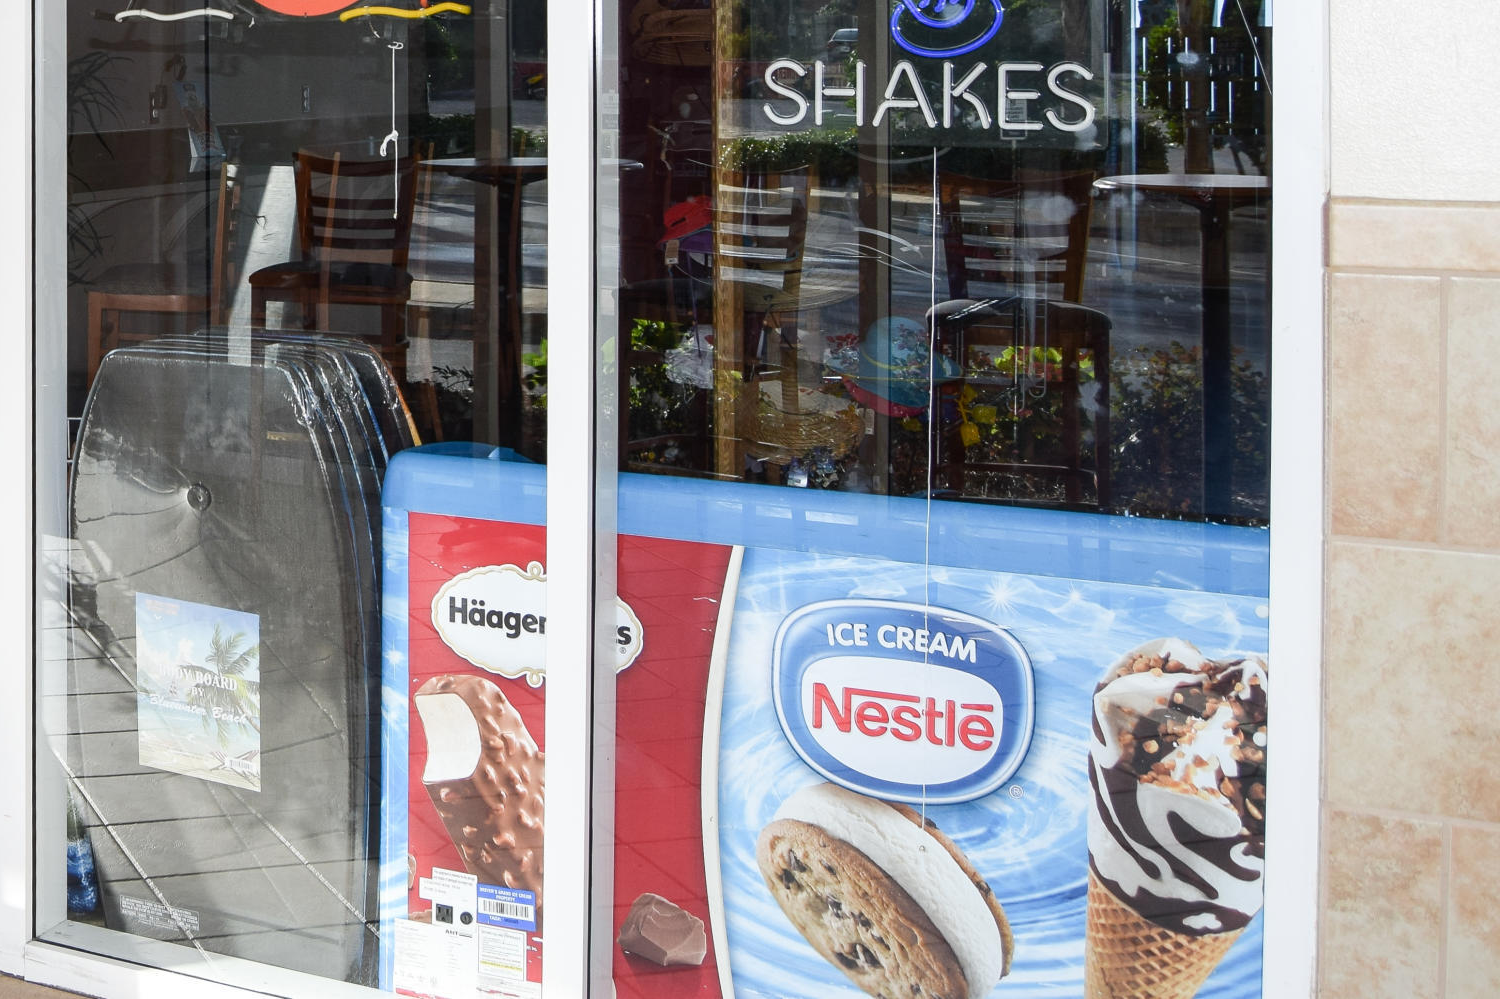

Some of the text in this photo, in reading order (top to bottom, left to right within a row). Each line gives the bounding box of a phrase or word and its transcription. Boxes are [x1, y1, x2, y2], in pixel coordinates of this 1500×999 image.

[763, 58, 1095, 132] SHAKES
[826, 622, 977, 663] ICE CREAM
[191, 687, 204, 697] BY
[195, 671, 238, 692] BOARD
[212, 706, 247, 725] Beach
